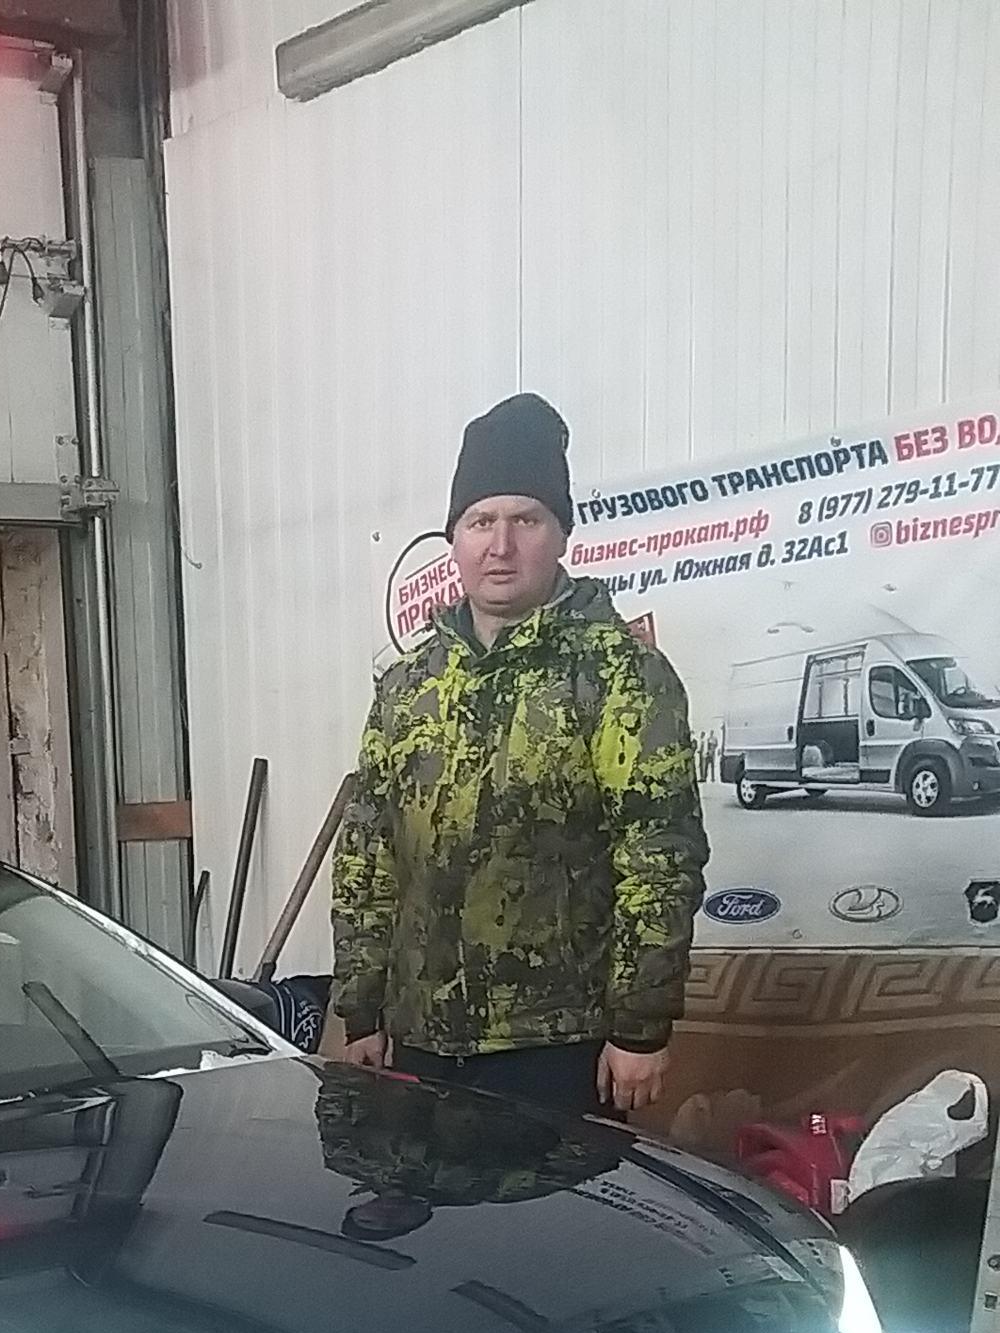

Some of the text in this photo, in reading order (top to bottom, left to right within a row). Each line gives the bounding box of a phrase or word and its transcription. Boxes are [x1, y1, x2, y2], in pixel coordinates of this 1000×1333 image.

[576, 414, 1000, 525] ГРУЗОВОГО ТРАНСПОРТА БЕЗ ВО
[798, 464, 1000, 524] 8 (977) 279-11-77
[571, 509, 769, 566] бизнес-прокат.рф
[398, 558, 457, 606] БИЗНЕС
[638, 569, 668, 595] ул.
[673, 552, 752, 583] Южная
[757, 543, 775, 568] д.
[717, 893, 763, 917] Ford
